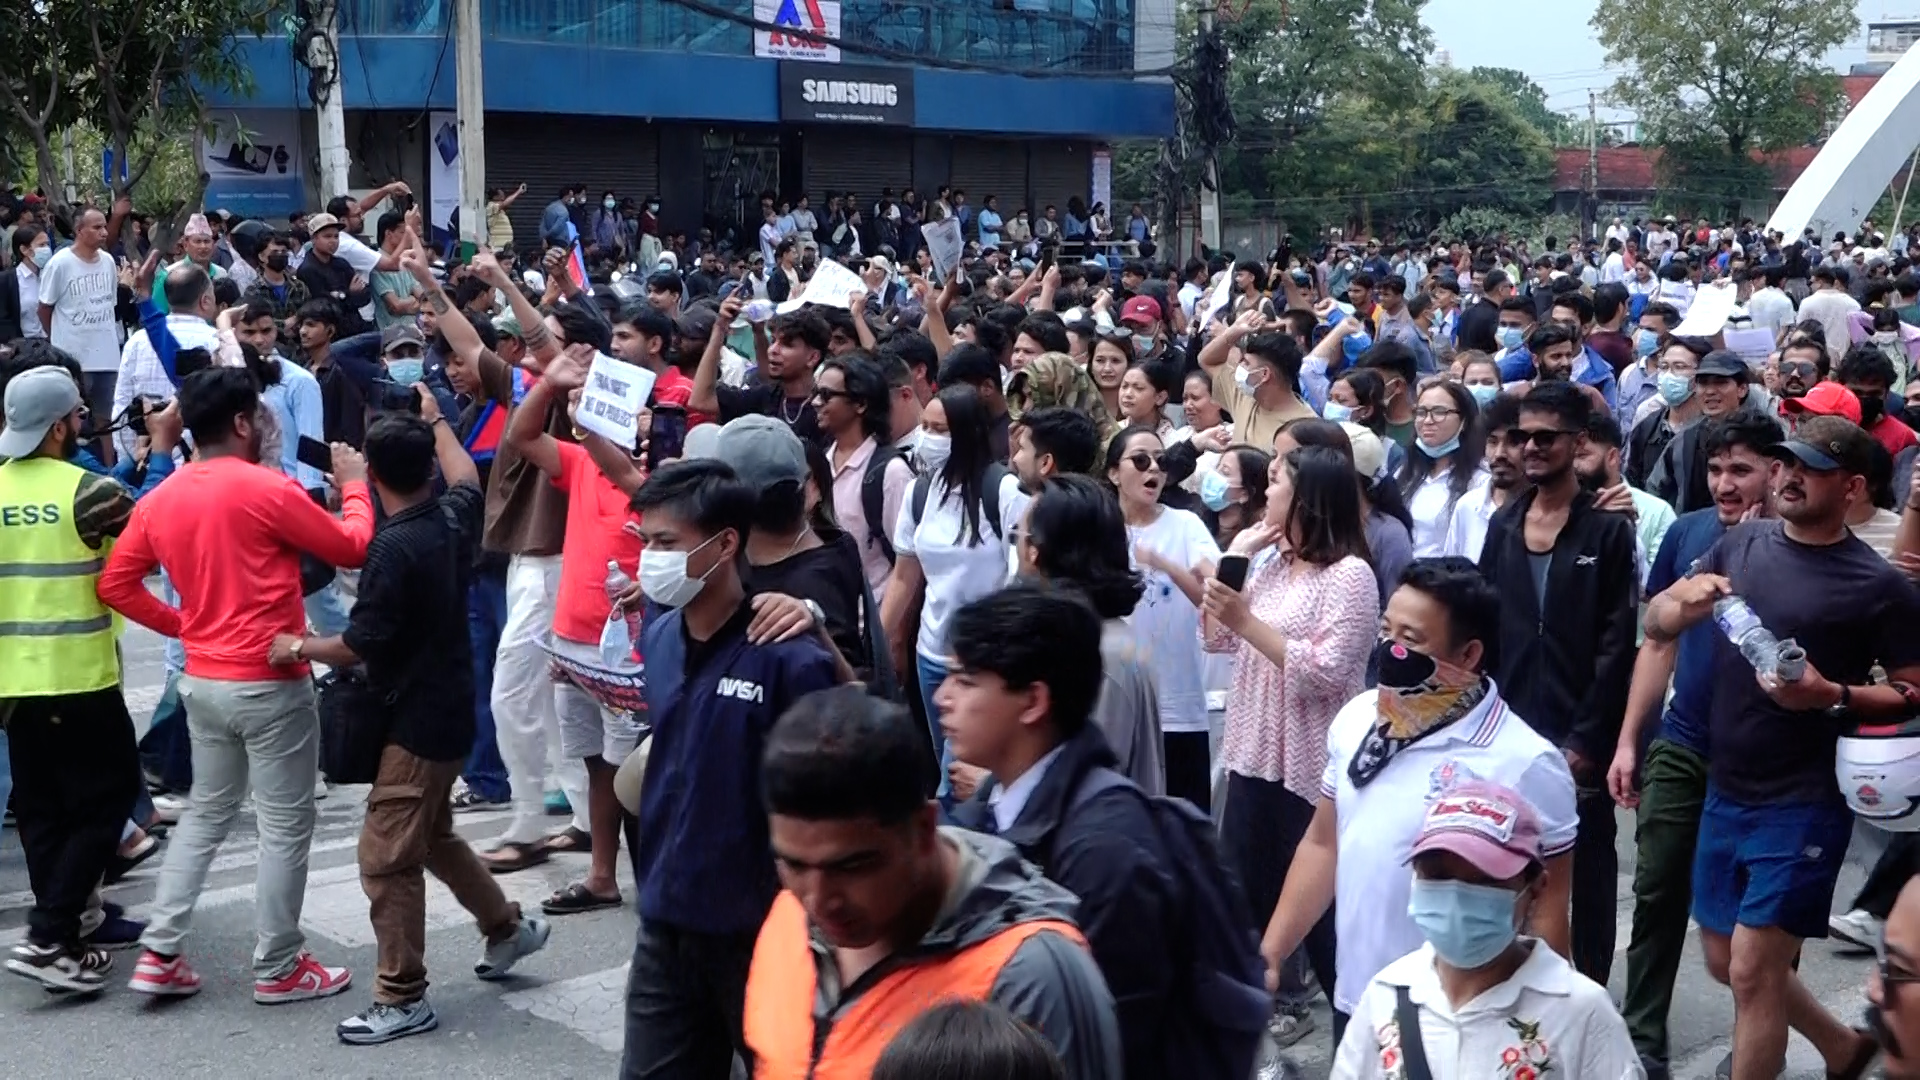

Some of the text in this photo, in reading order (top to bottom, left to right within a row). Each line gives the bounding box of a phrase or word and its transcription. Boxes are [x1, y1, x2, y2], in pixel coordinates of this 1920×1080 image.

[802, 79, 898, 106] SAMSUNG
[0, 503, 60, 526] ESS
[716, 677, 764, 704] NASA
